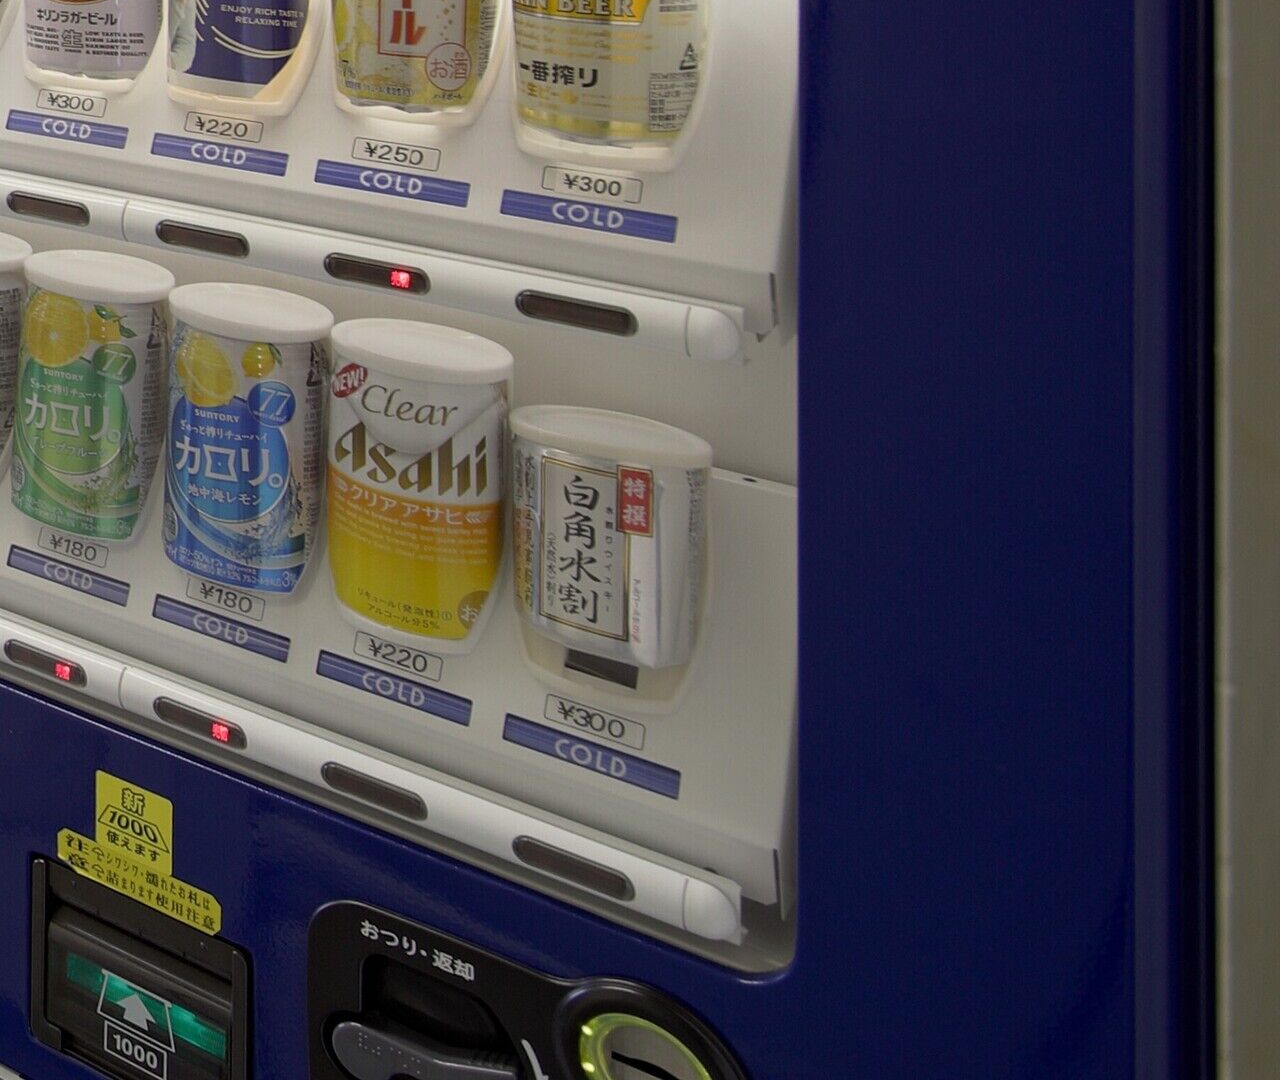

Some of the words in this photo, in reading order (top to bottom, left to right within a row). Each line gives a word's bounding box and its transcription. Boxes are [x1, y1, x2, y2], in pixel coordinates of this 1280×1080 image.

[36, 8, 119, 26] キリンラガービール
[220, 4, 252, 16] ENJOY
[254, 6, 277, 17] RICH
[234, 15, 280, 27] RELAXING
[429, 57, 468, 80] お酒
[519, 60, 599, 88] 一番搾り
[46, 92, 95, 112] ¥300
[41, 118, 91, 139] COLD
[195, 115, 249, 138] ¥220
[191, 142, 247, 165] COLD
[363, 141, 424, 166] ¥250
[359, 170, 424, 195] COLD
[563, 174, 622, 197] ¥300
[552, 202, 625, 229] COLD
[43, 368, 84, 382] SUNTORY
[104, 349, 132, 375] 77
[334, 369, 365, 396] NEW!
[194, 408, 240, 423] SUNTORY
[259, 387, 291, 417] 77
[359, 383, 458, 427] Clear
[24, 391, 122, 444] カロリ。
[175, 435, 284, 489] カロリ。
[334, 420, 488, 498] Asahi
[187, 485, 262, 506] 地中海レモン
[49, 534, 98, 561] ¥180
[557, 474, 602, 624] 白角水割
[43, 563, 94, 590] COLD
[198, 583, 253, 613] ¥180
[192, 614, 249, 646] COLD
[368, 637, 429, 673] ¥220
[361, 672, 426, 708] COLD
[556, 700, 626, 739] ¥300
[553, 735, 628, 779] COLD
[121, 787, 146, 818] 新
[107, 808, 159, 844] 1000
[106, 829, 161, 863] 使えます
[105, 871, 217, 932] 詰まります使用注意
[359, 918, 475, 983] おつり・返却
[112, 1032, 159, 1070] 1000
